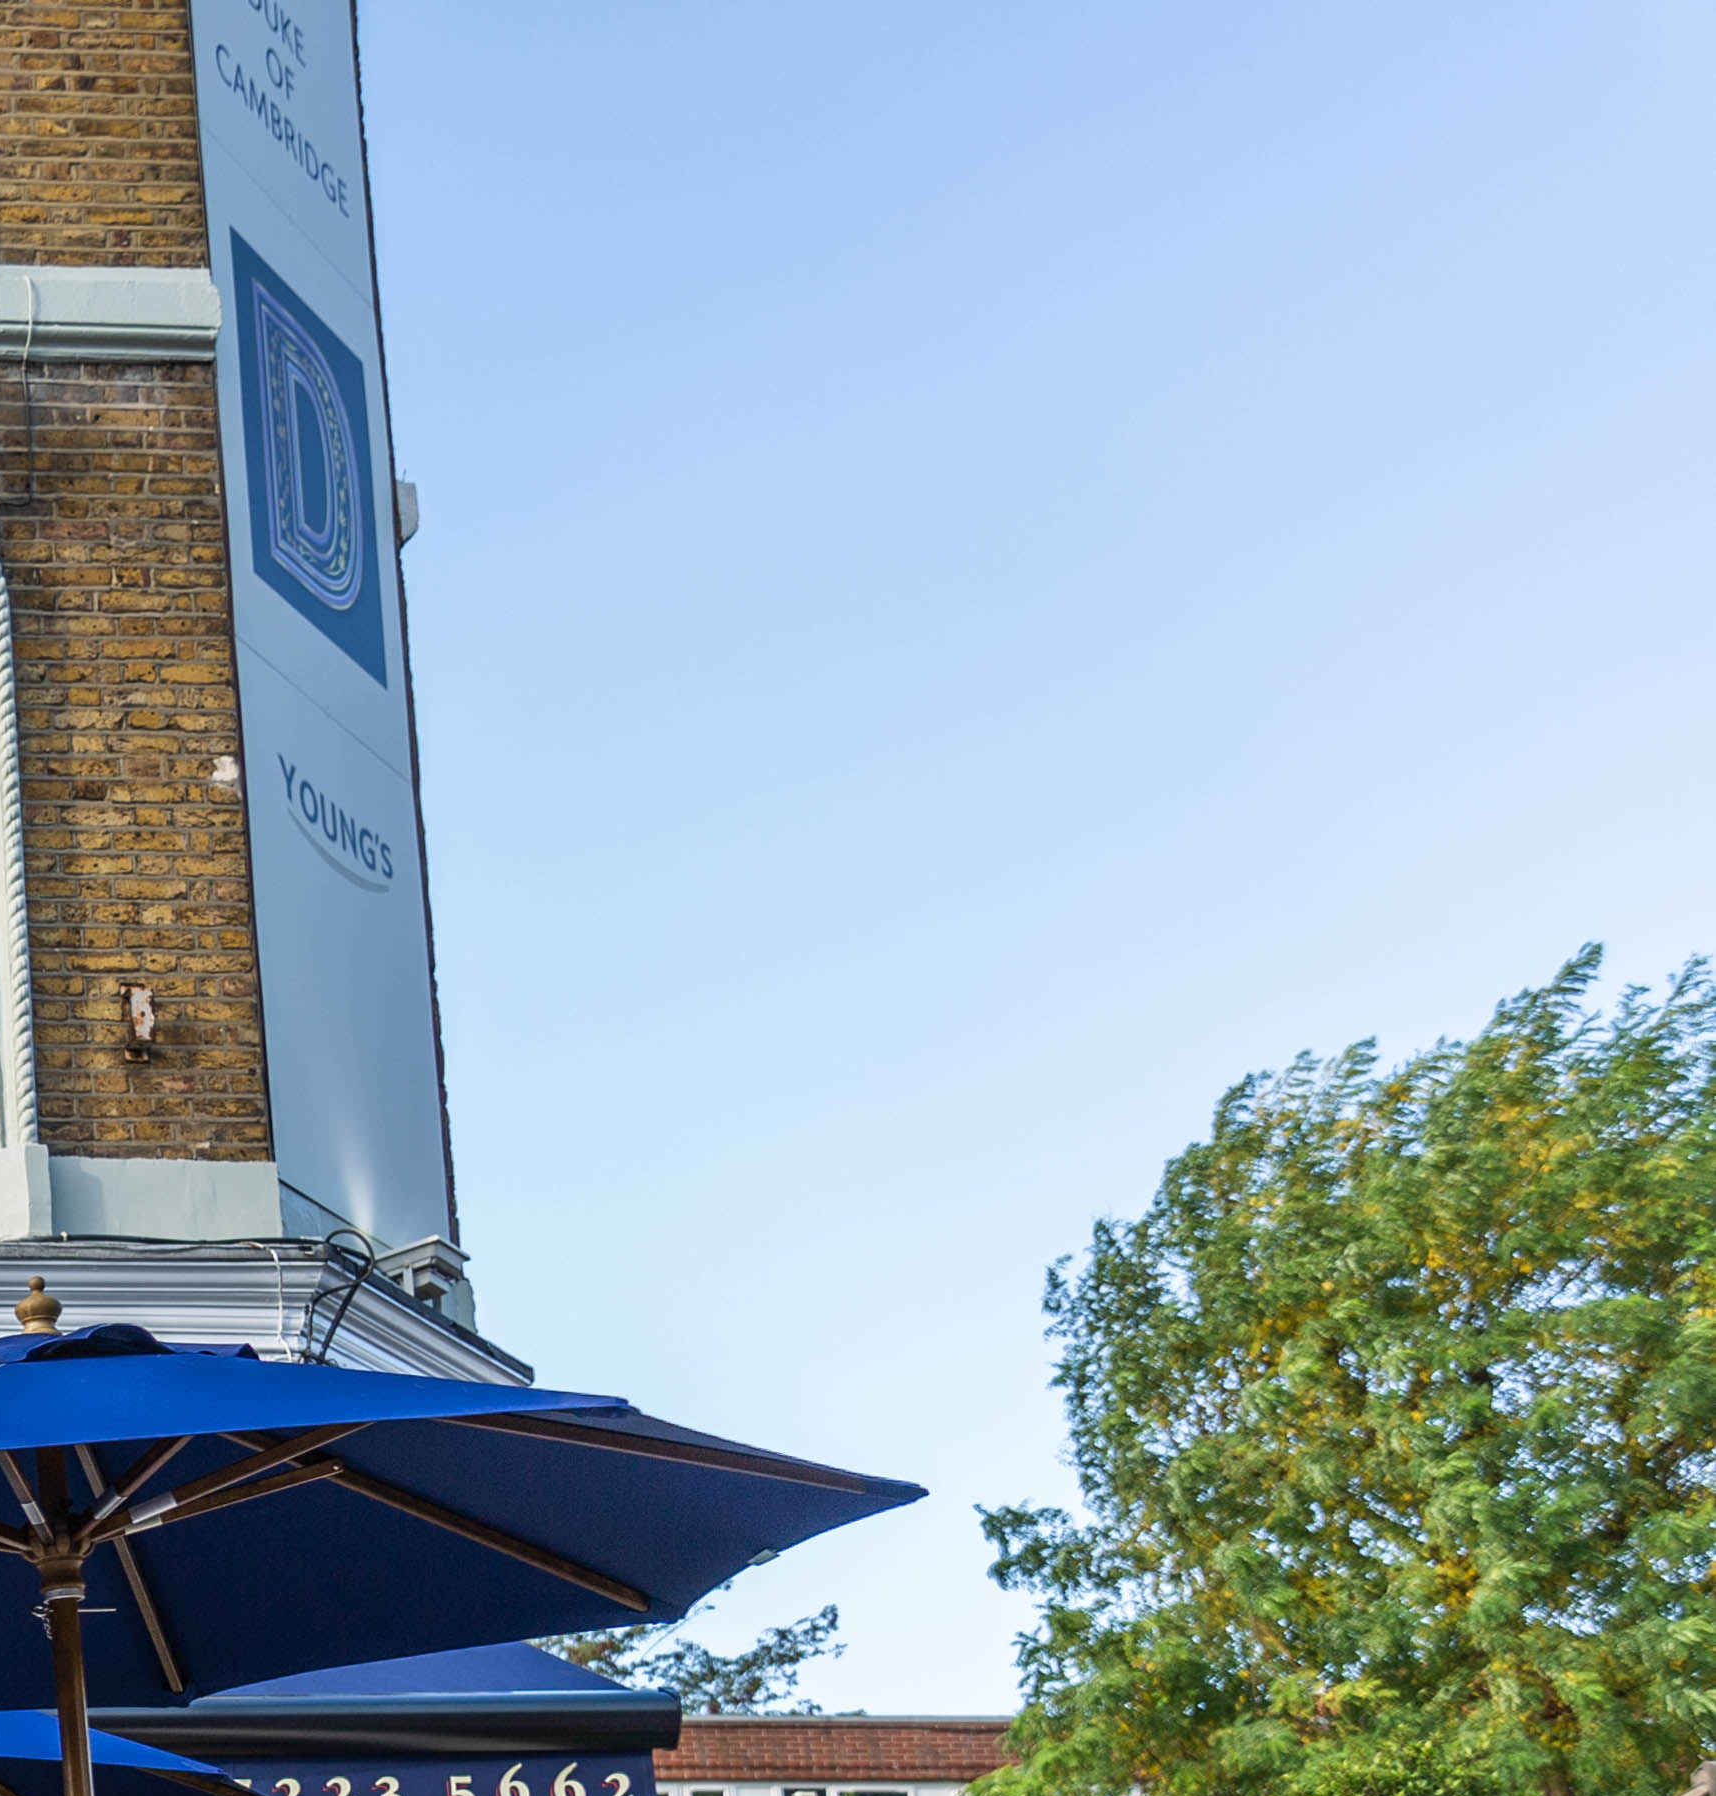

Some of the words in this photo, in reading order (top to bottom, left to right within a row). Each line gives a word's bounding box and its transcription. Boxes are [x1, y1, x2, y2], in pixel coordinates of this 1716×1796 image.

[215, 43, 350, 219] CAMBRIDGE
[265, 47, 295, 100] OF
[276, 752, 394, 880] YOUNG'S
